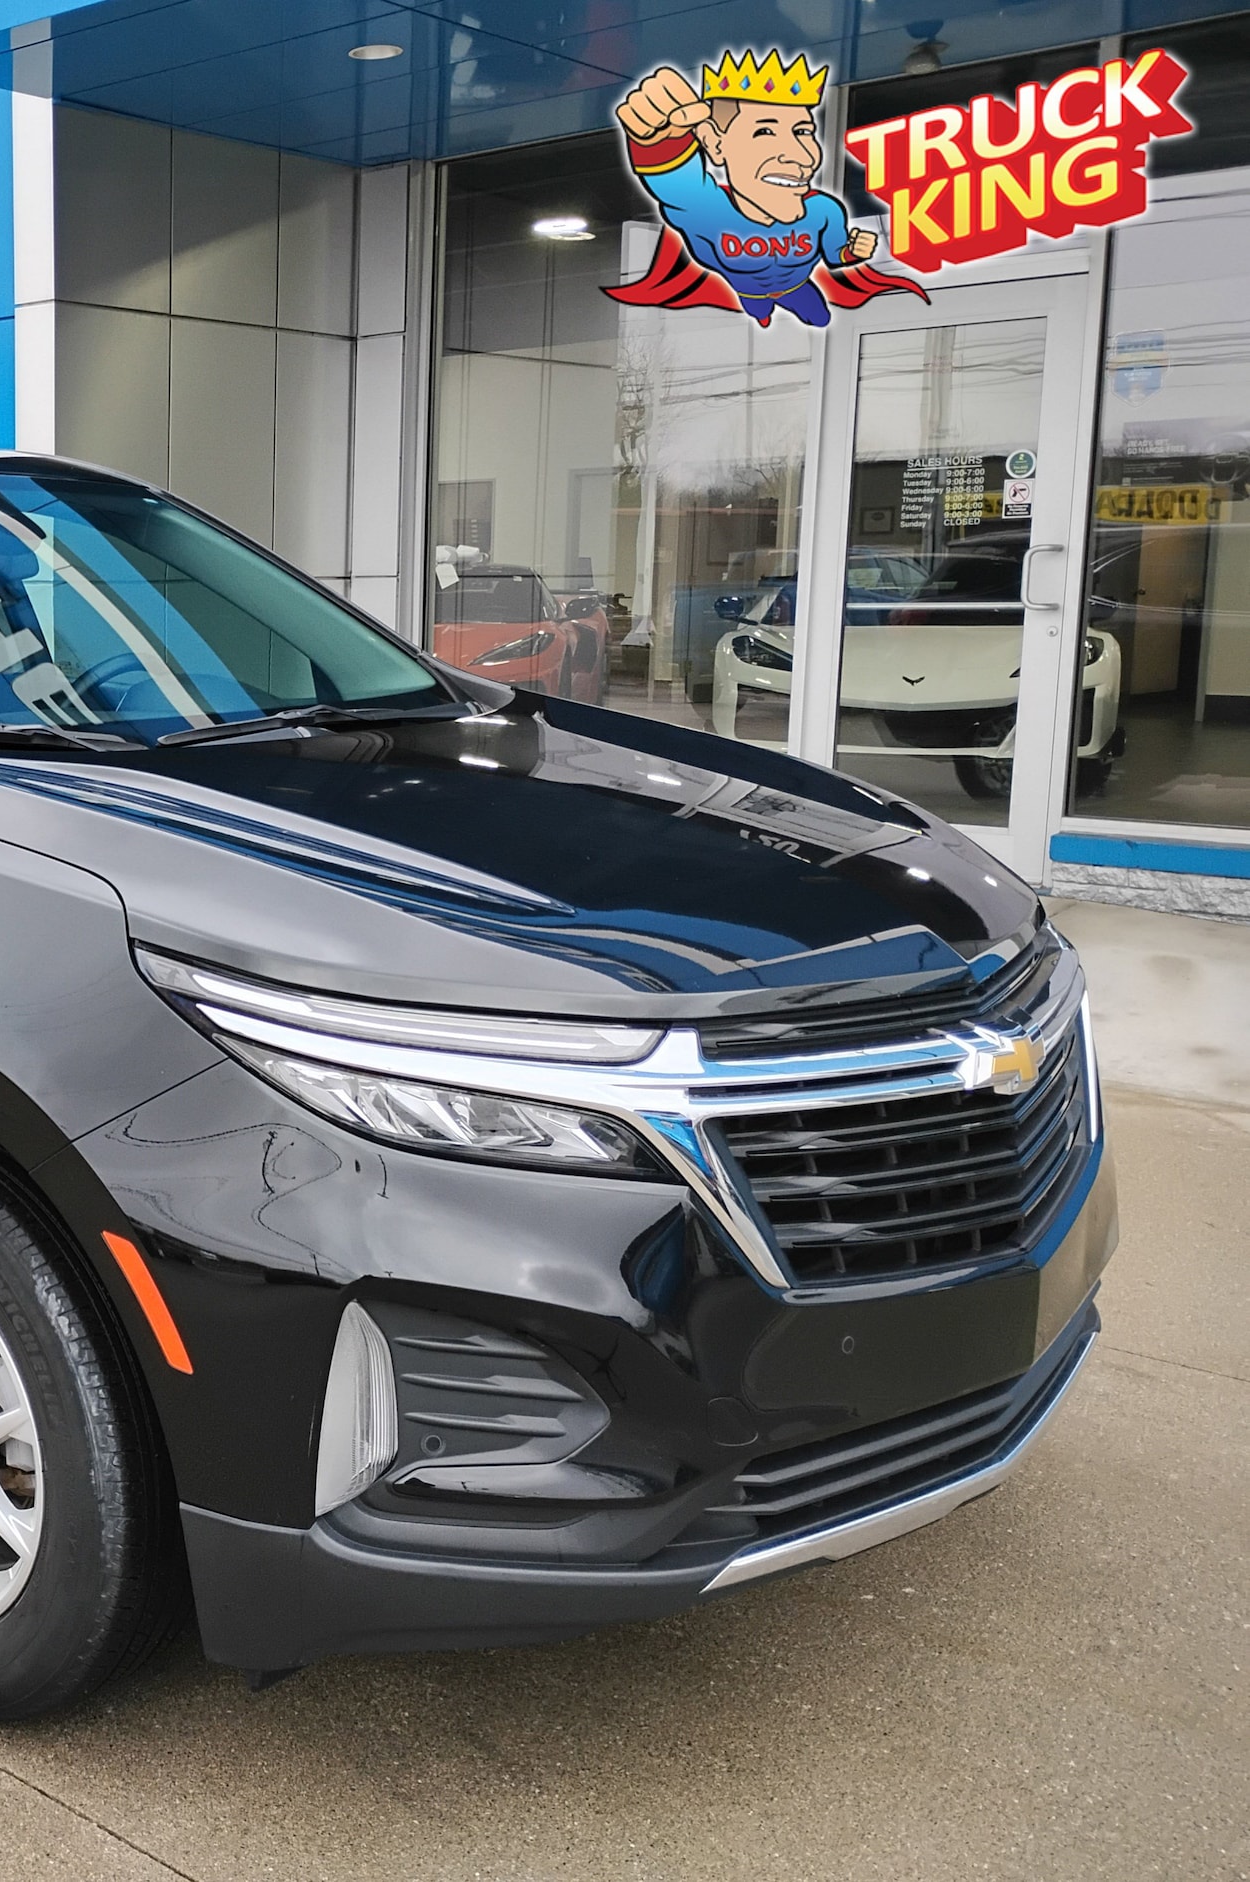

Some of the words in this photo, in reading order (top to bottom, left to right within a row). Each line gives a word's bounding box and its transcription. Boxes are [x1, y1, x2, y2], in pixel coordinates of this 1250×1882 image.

[907, 457, 942, 468] SALES
[945, 455, 983, 466] HOURS
[903, 471, 932, 479] Monday
[902, 479, 932, 487] Tuesday
[902, 486, 944, 495] Wednesday
[902, 495, 935, 503] Thursday
[901, 504, 923, 512] Friday
[900, 512, 932, 520] Saturday
[900, 520, 927, 528] Sunday
[943, 518, 981, 526] CLOSED
